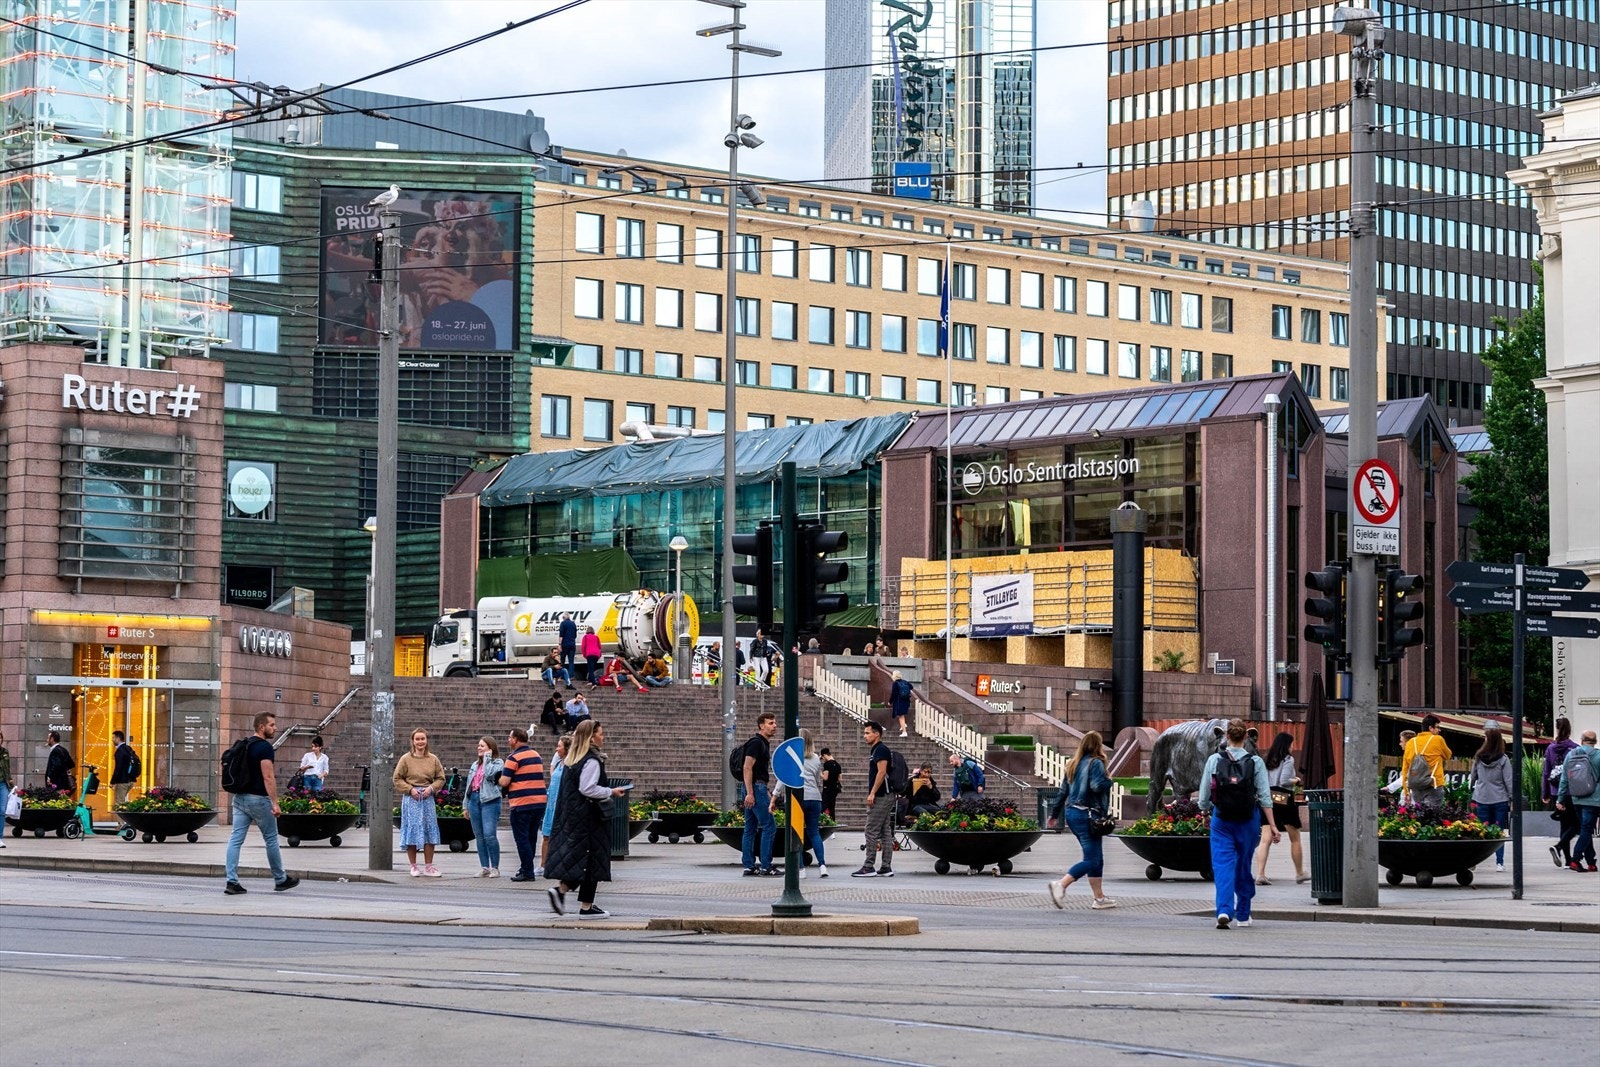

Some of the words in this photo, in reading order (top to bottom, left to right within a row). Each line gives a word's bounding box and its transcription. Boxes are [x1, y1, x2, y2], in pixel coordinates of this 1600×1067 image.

[897, 177, 930, 188] BLU
[335, 204, 371, 216] OSLO
[431, 320, 443, 329] 18.
[454, 321, 468, 329] 27.
[469, 321, 486, 331] juni
[432, 332, 485, 342] oslopride.no
[62, 373, 201, 418] Ruter#
[989, 463, 1024, 486] Oslo
[1026, 455, 1140, 483] Sentralstasjon
[1356, 529, 1380, 540] Gjelder
[1383, 530, 1397, 540] ikke
[1356, 541, 1373, 551] buss
[1381, 543, 1397, 552] rute
[986, 588, 1018, 608] STILLBYGG
[1527, 593, 1571, 601] Havnepromenaden
[119, 628, 147, 638] Ruter
[148, 628, 155, 638] S
[1557, 641, 1565, 666] Oslo
[98, 661, 133, 671] Cusomer
[134, 664, 160, 672] seice
[990, 679, 1013, 693] Ruter
[1014, 680, 1021, 694] S
[1557, 667, 1566, 703] Visitor
[48, 723, 73, 731] Service
